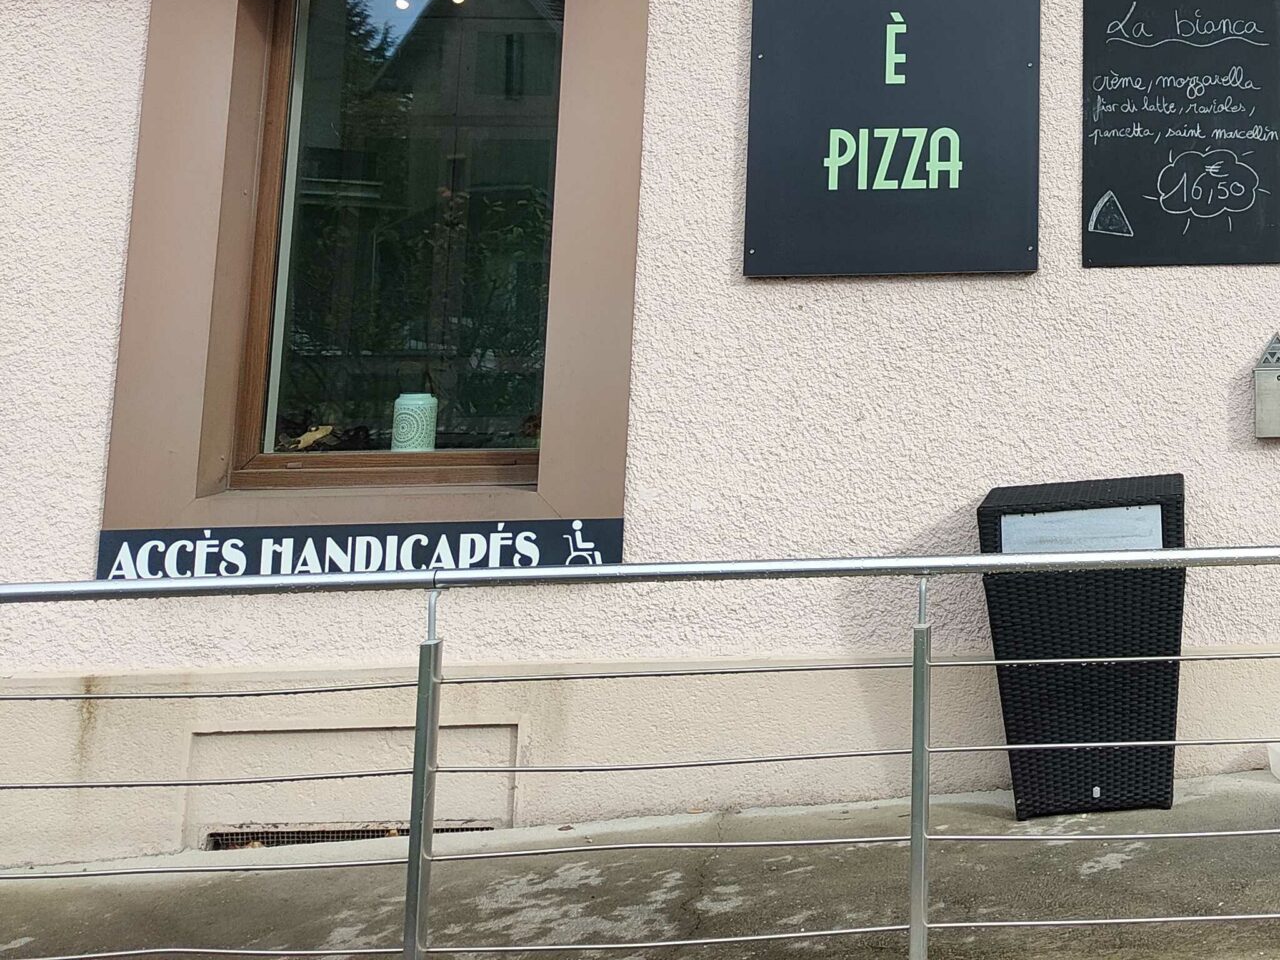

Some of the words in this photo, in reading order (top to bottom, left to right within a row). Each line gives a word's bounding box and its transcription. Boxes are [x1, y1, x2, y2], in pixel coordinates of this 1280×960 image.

[1106, 1, 1153, 38] La
[1175, 8, 1264, 36] bianca
[884, 12, 906, 84] È
[1155, 66, 1262, 100] mozzarella
[1165, 122, 1206, 139] saint
[1211, 125, 1279, 142] marcellin
[824, 127, 963, 191] PIZZA
[108, 529, 247, 580] ACCÈS
[259, 522, 540, 576] HANDICAPÉS
